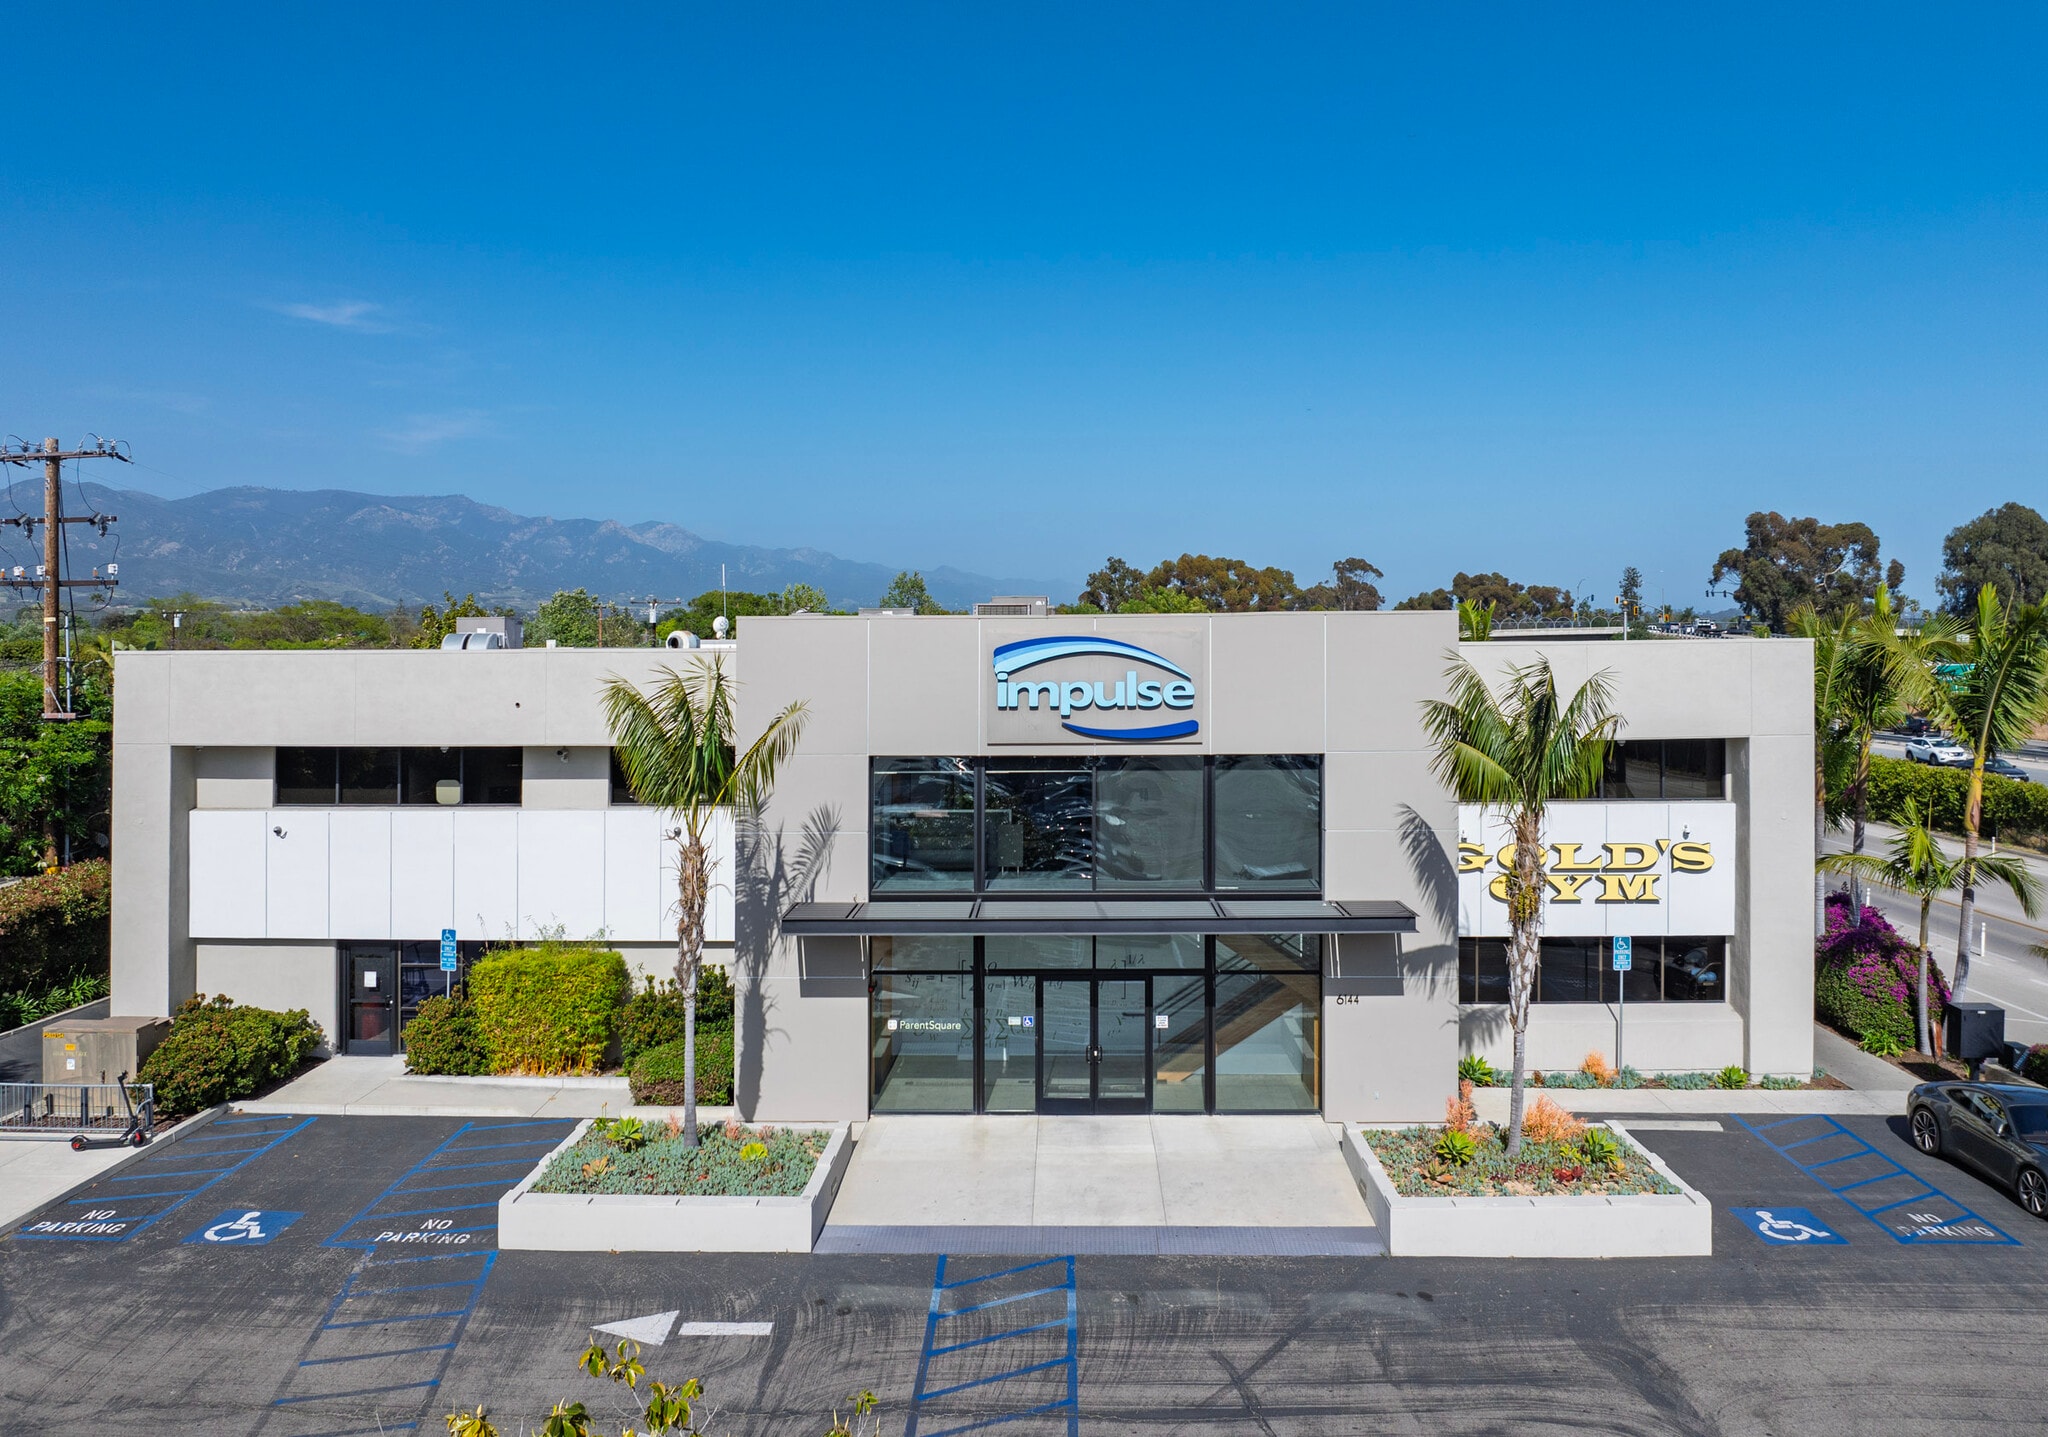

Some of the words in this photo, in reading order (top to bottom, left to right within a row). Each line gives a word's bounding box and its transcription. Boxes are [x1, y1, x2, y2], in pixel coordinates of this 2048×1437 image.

[996, 670, 1196, 717] impulse
[1336, 994, 1359, 1006] 6144
[900, 1020, 962, 1032] ParentSquare
[80, 1209, 117, 1220] NO
[1906, 1213, 1943, 1223] NO
[27, 1221, 127, 1234] PARKING
[420, 1219, 454, 1230] NO
[374, 1231, 471, 1244] PARKING
